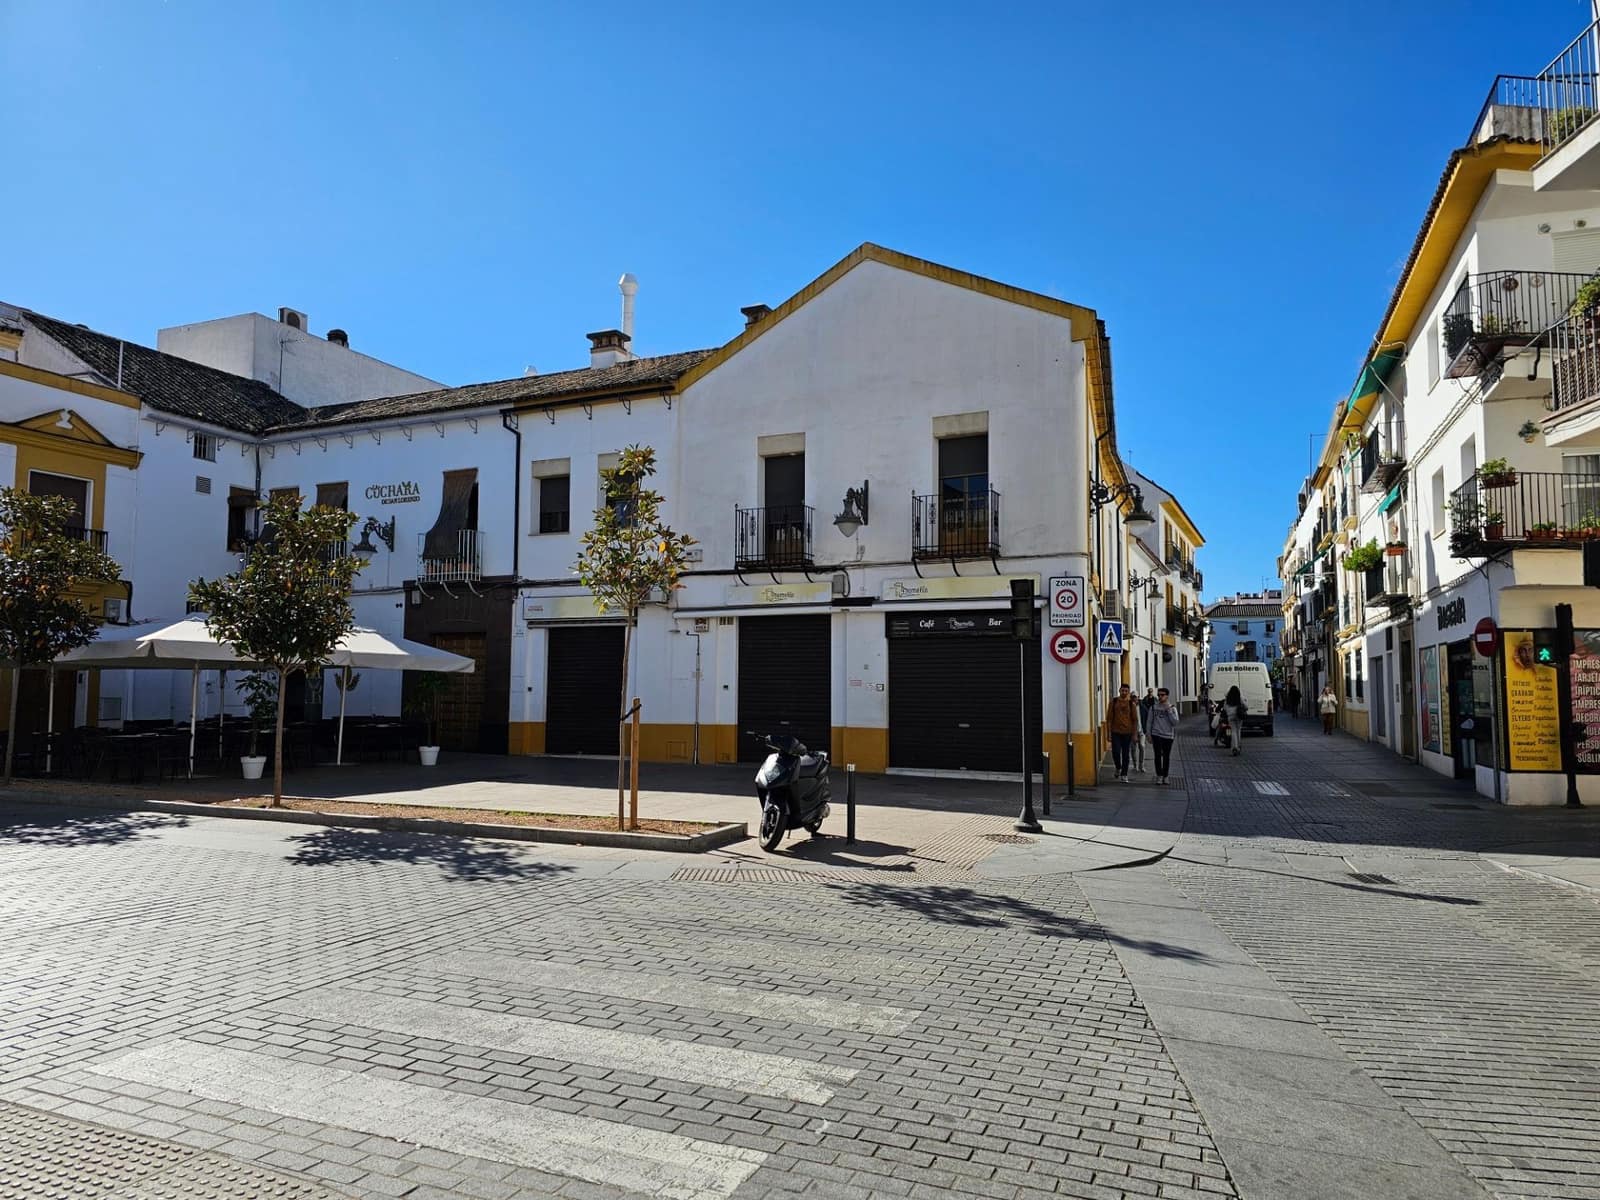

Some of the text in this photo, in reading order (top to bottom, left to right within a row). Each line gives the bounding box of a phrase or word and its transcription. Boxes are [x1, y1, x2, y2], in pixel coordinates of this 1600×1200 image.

[365, 481, 420, 499] CUCHARA
[919, 619, 935, 629] Café
[988, 618, 1003, 626] Bar
